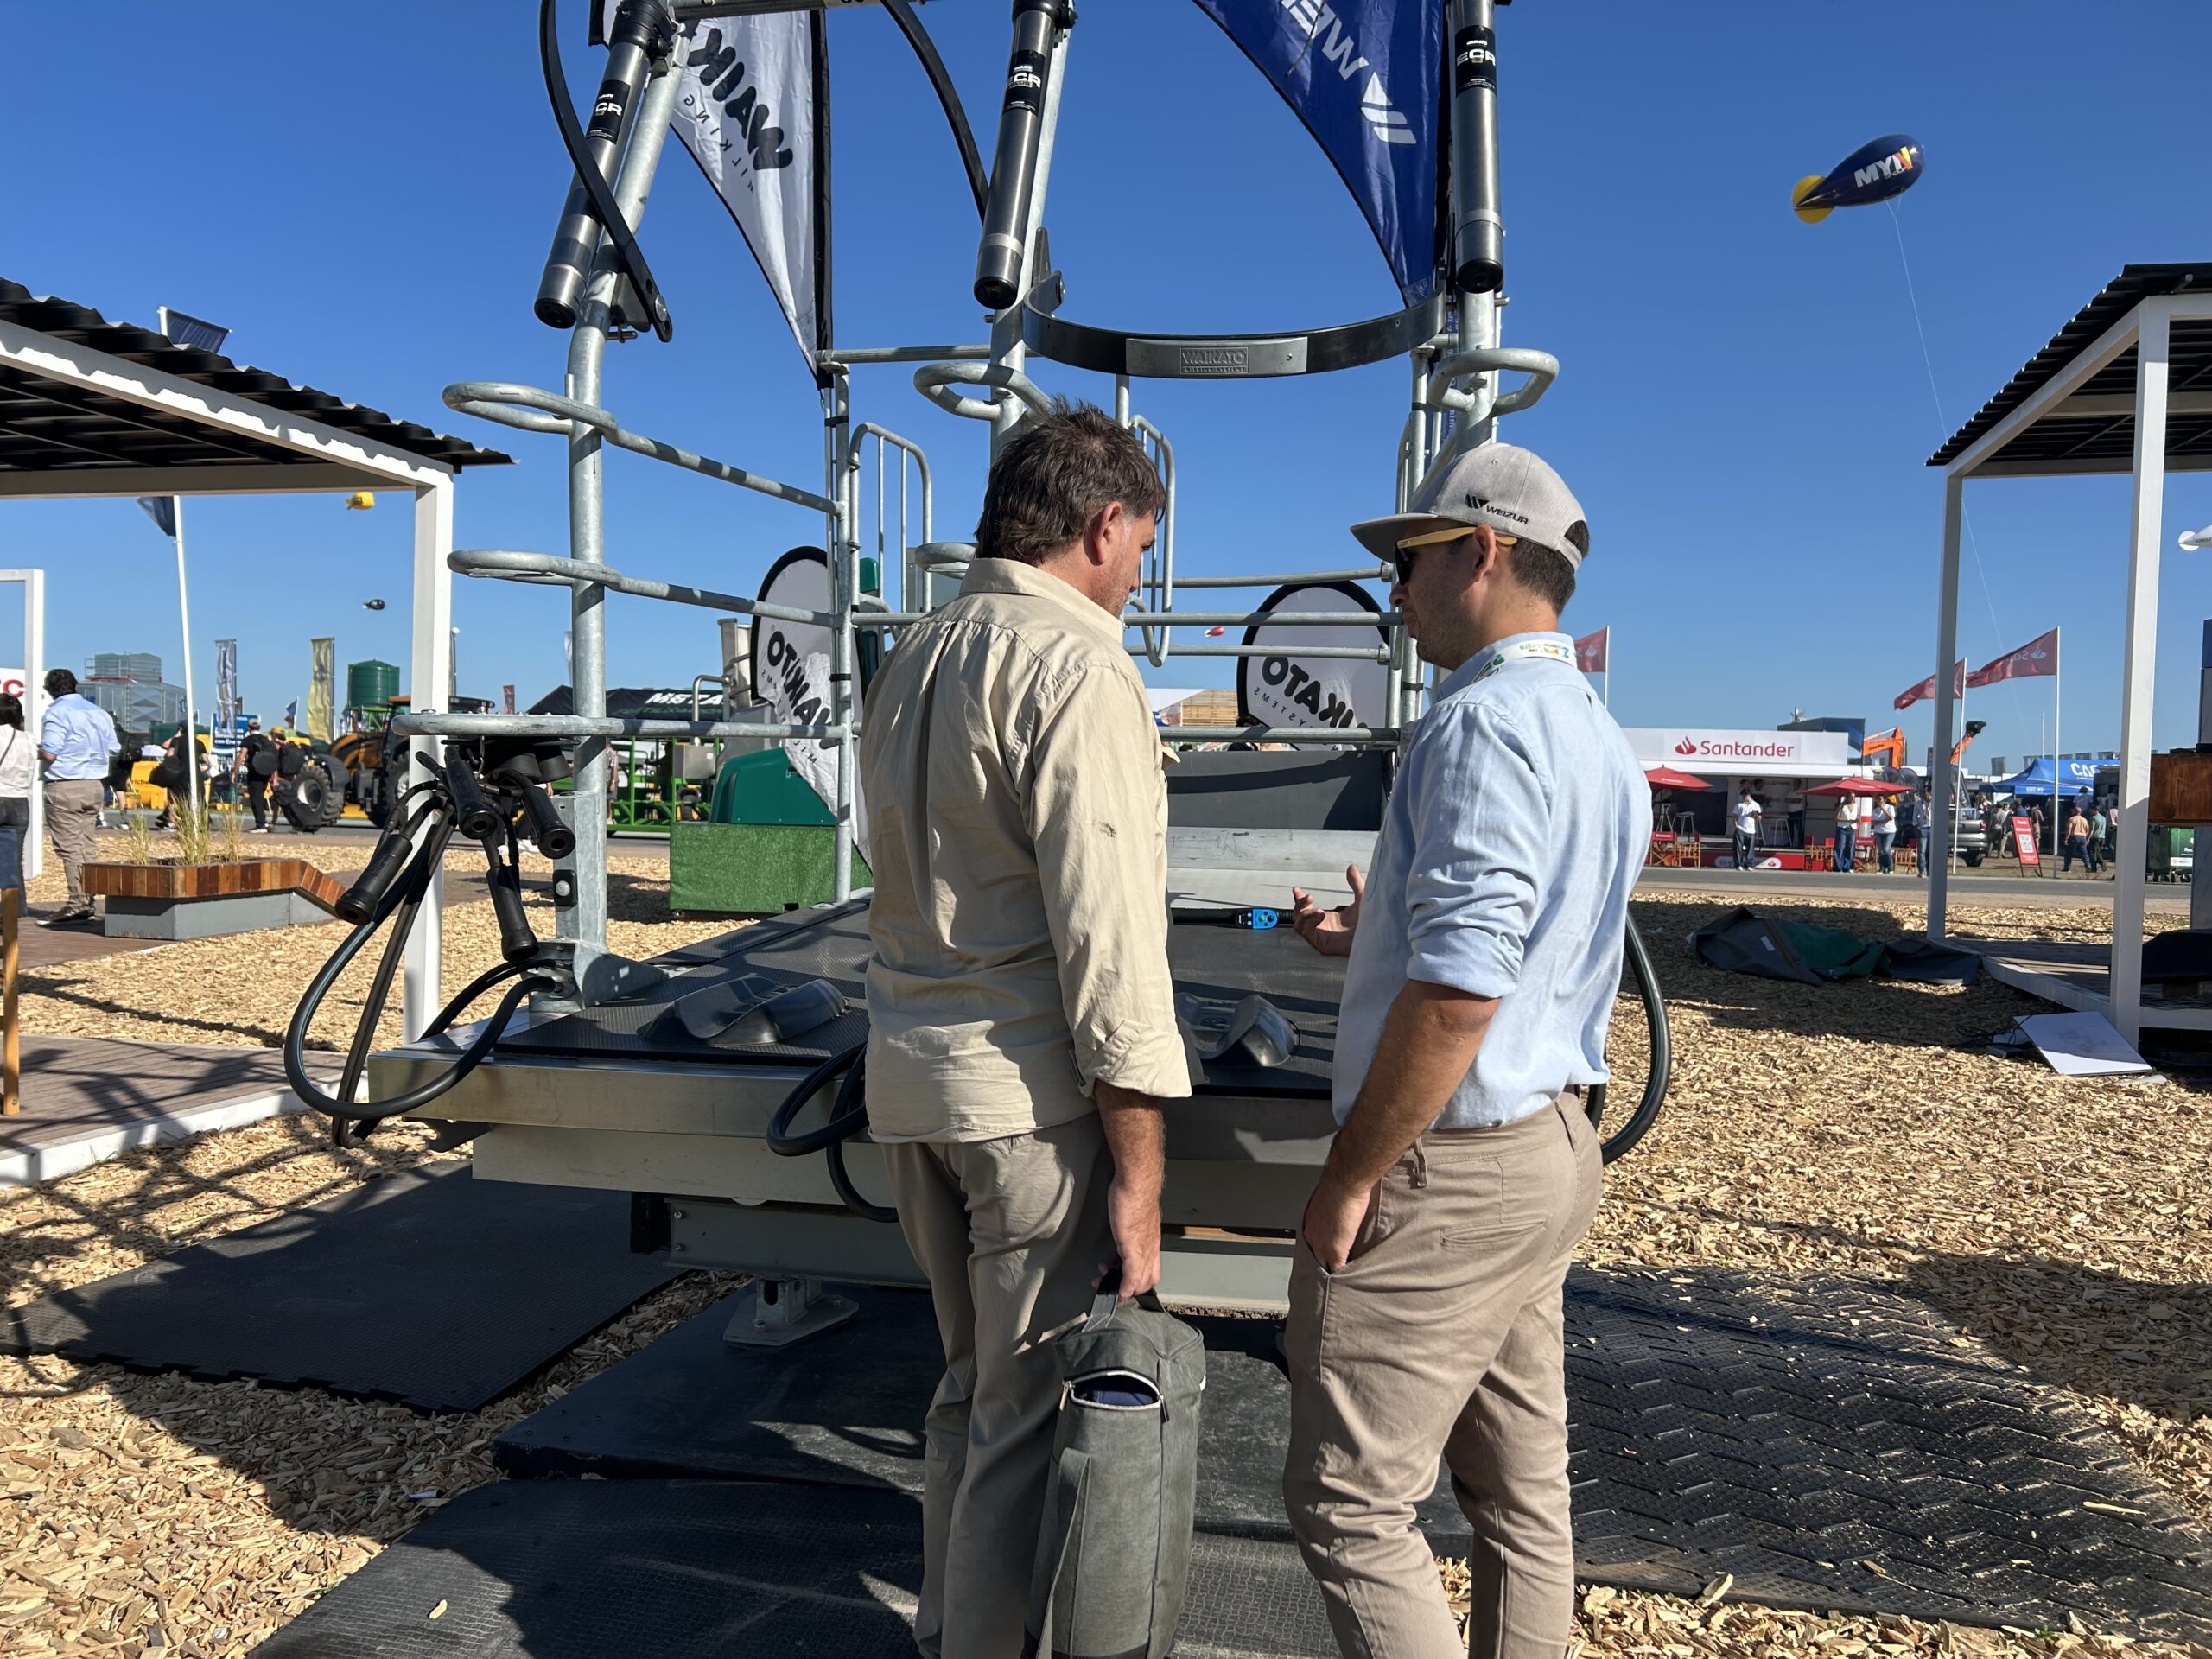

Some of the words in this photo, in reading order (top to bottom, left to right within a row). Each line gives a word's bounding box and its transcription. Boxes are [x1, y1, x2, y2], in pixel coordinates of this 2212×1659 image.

[1456, 48, 1496, 67] ECR
[594, 102, 623, 117] CR
[1182, 352, 1245, 364] WAIKATO
[1486, 505, 1529, 525] WEIZUR
[1700, 741, 1794, 757] Santander
